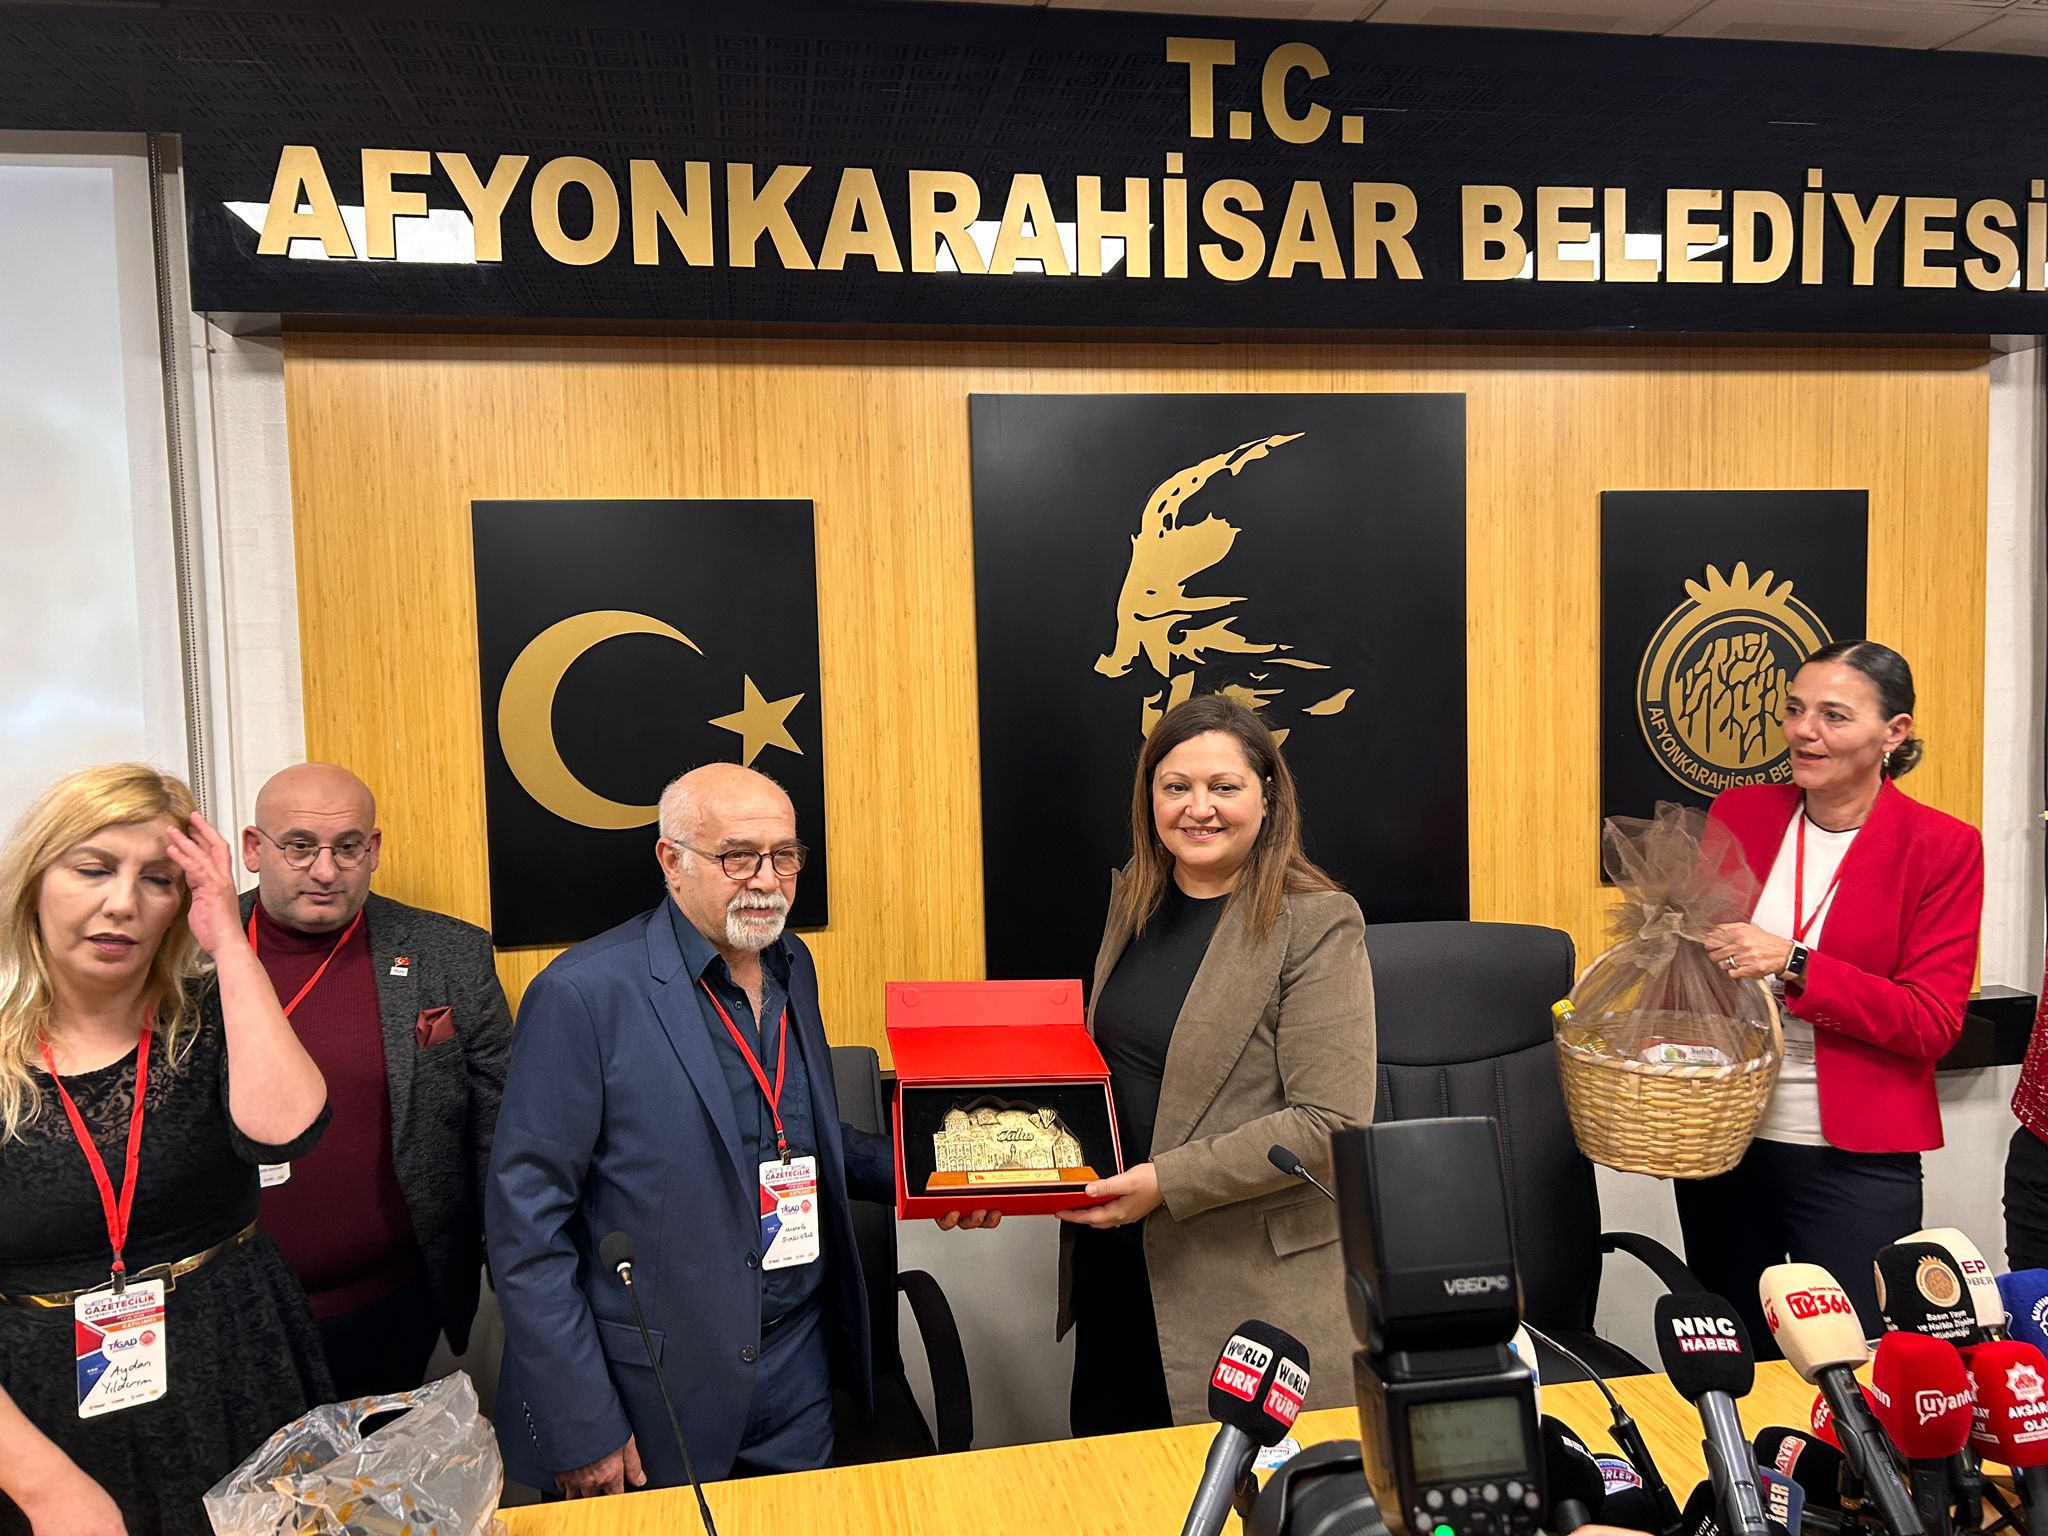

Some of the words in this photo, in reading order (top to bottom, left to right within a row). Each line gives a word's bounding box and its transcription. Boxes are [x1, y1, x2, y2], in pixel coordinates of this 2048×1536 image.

[1166, 36, 1364, 144] T.C.
[256, 145, 1424, 282] AFYONKARAHİSAR
[1461, 168, 2046, 292] BELEDİYESİ
[1769, 758, 1792, 783] BE
[84, 1294, 155, 1316] GAZETECİLİK
[1671, 1316, 1737, 1337] NNC
[1227, 1340, 1268, 1369] WORLD
[1680, 1337, 1741, 1353] HABER
[1216, 1363, 1259, 1396] TÜRK
